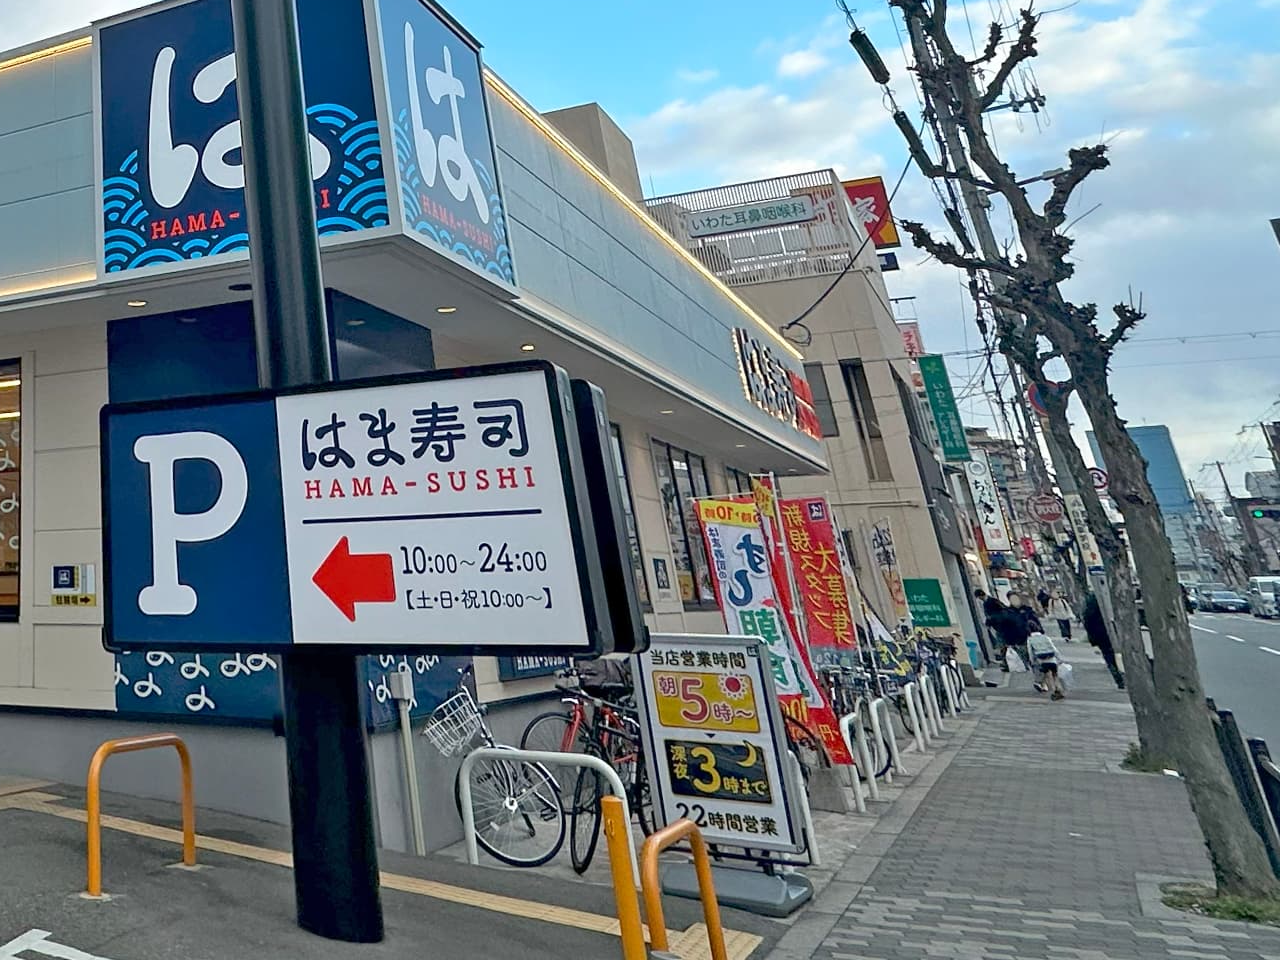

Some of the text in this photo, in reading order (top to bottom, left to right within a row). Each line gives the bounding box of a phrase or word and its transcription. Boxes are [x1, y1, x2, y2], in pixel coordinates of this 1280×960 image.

[404, 22, 489, 224] は
[692, 201, 806, 230] いわた耳鼻咽喉科
[302, 398, 529, 471] はま寿司
[305, 466, 536, 500] HAMA-SUSHI
[133, 431, 248, 616] P
[650, 650, 746, 669] 当店営業時間
[671, 745, 767, 795] 深夜 3時まで
[676, 803, 778, 836] 22時間営業
